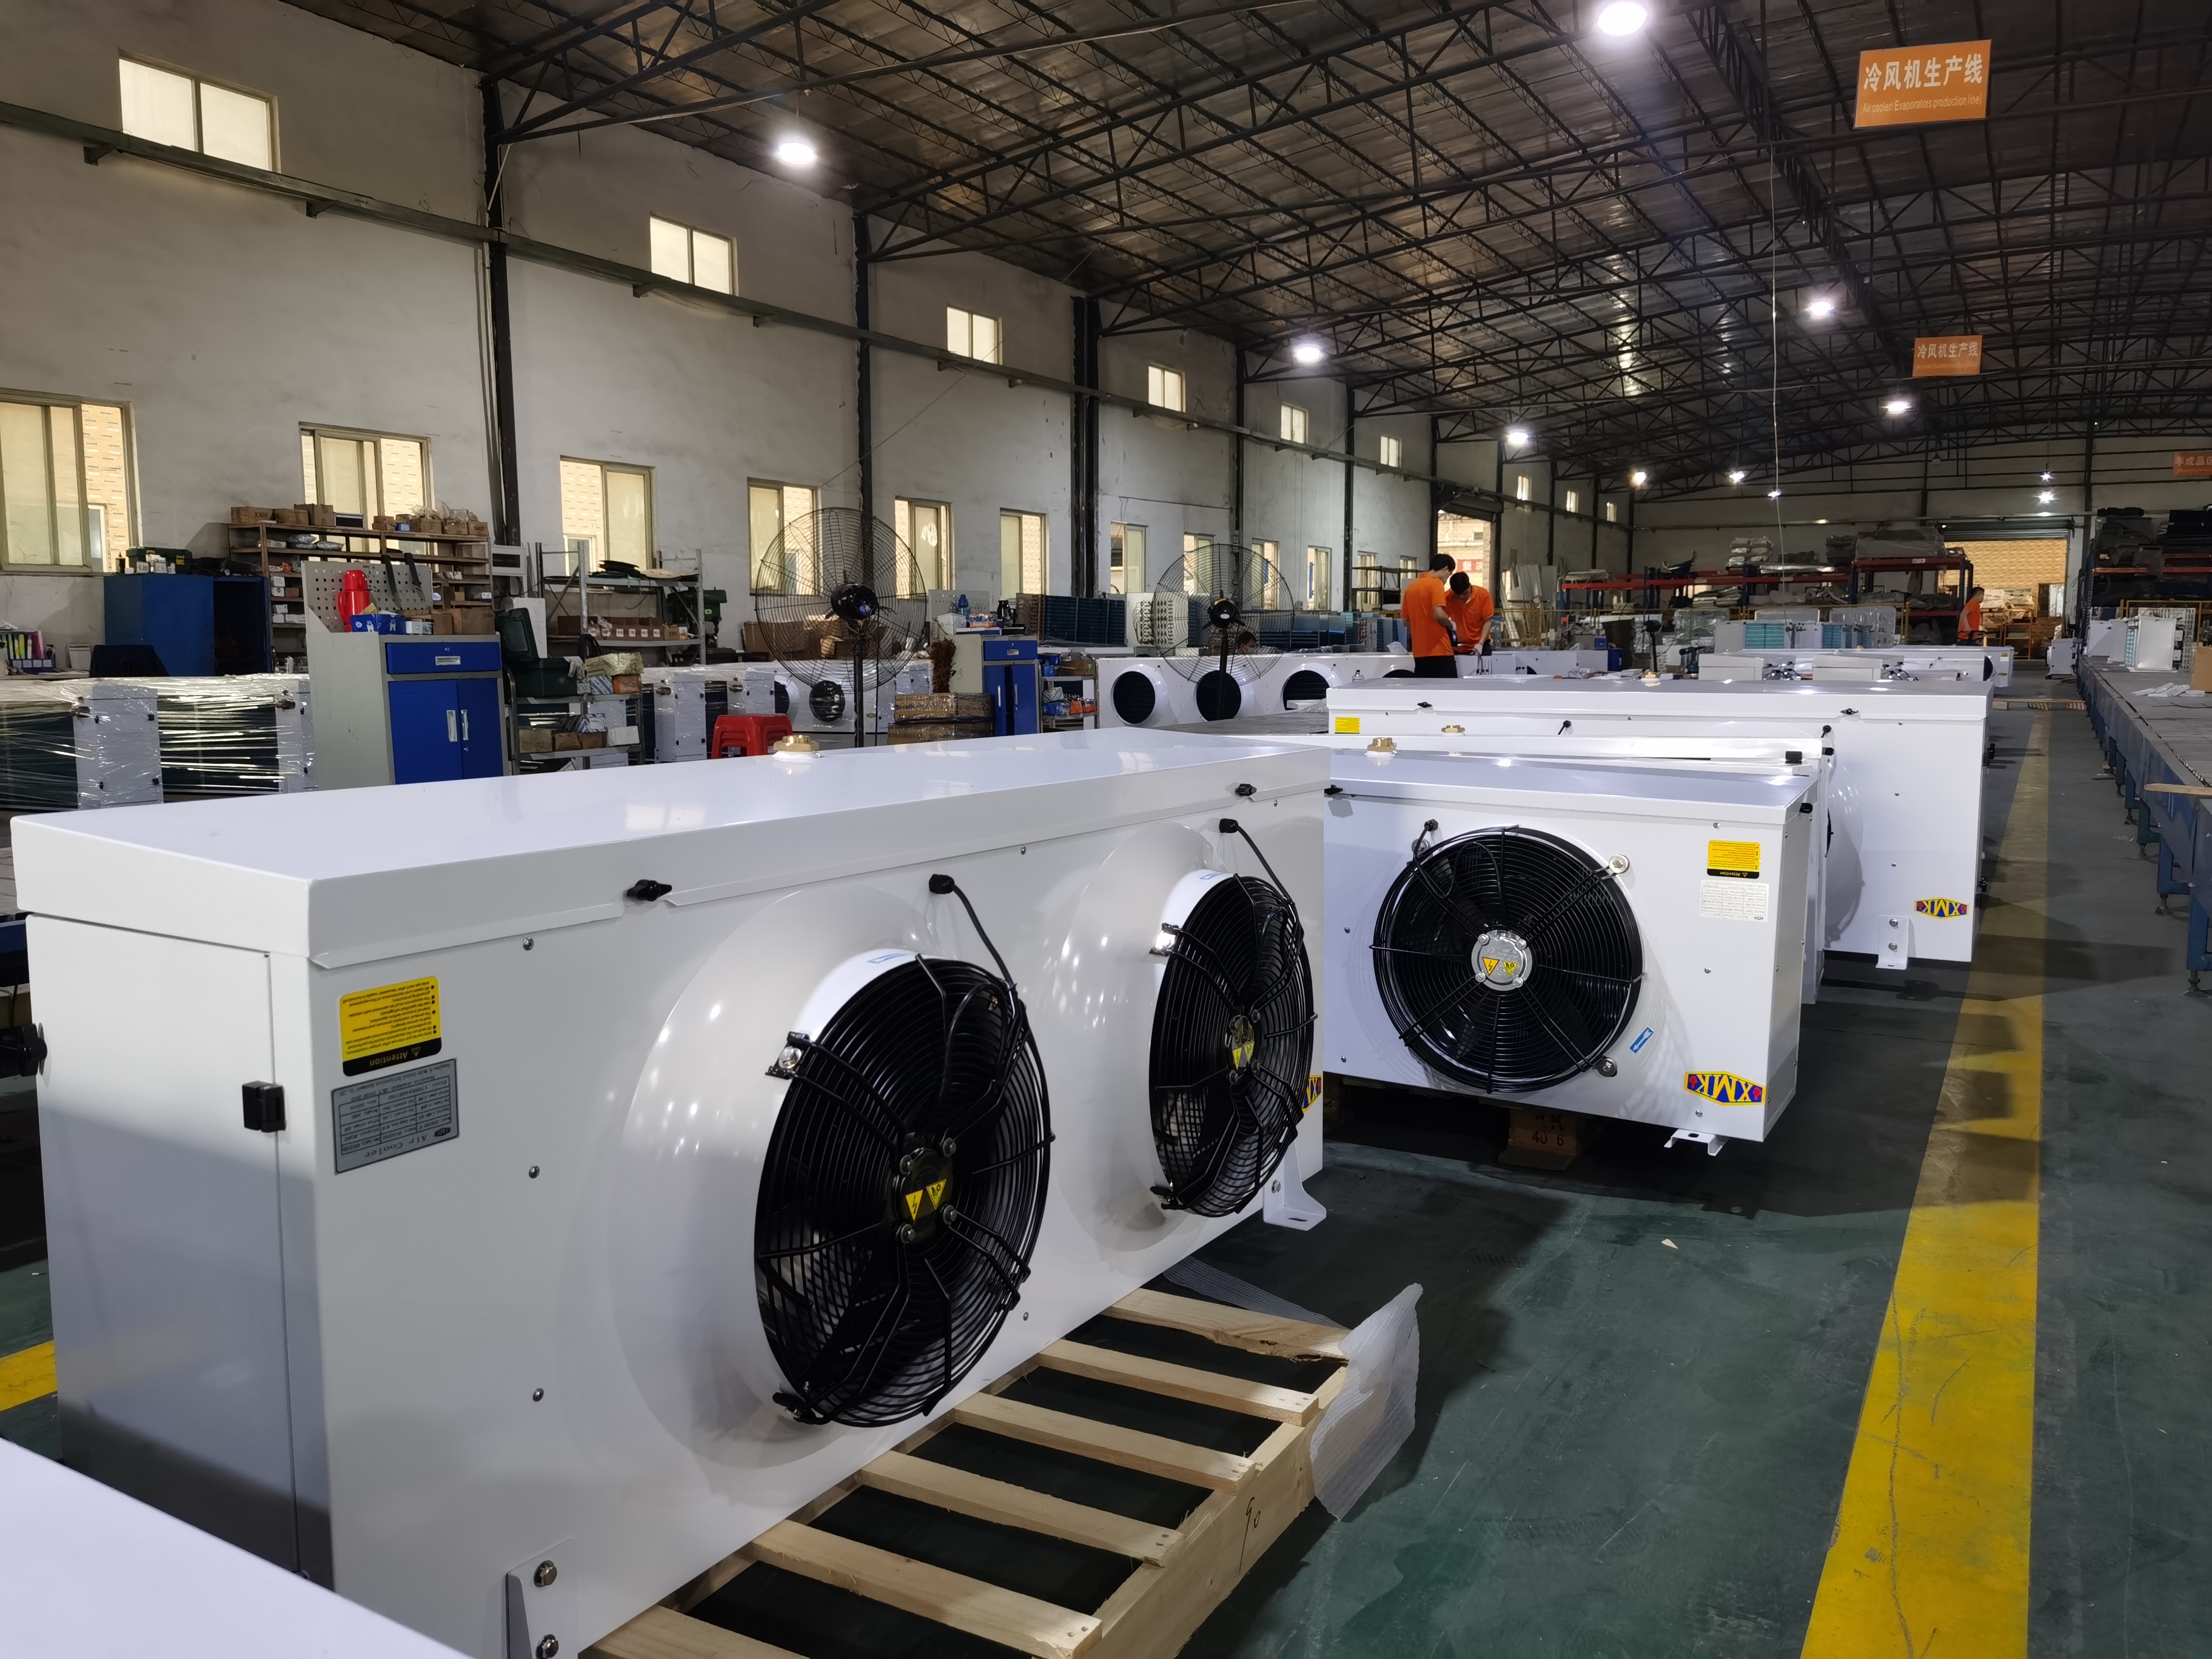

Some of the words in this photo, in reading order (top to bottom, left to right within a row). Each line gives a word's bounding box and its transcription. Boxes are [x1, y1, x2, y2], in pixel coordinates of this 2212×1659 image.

[1863, 53, 1983, 93] 冷风机生产线
[1917, 341, 1978, 359] 冷风机生产线
[1921, 899, 1960, 917] XMK
[369, 1050, 408, 1066] Attention
[1695, 1073, 1753, 1102] XMK
